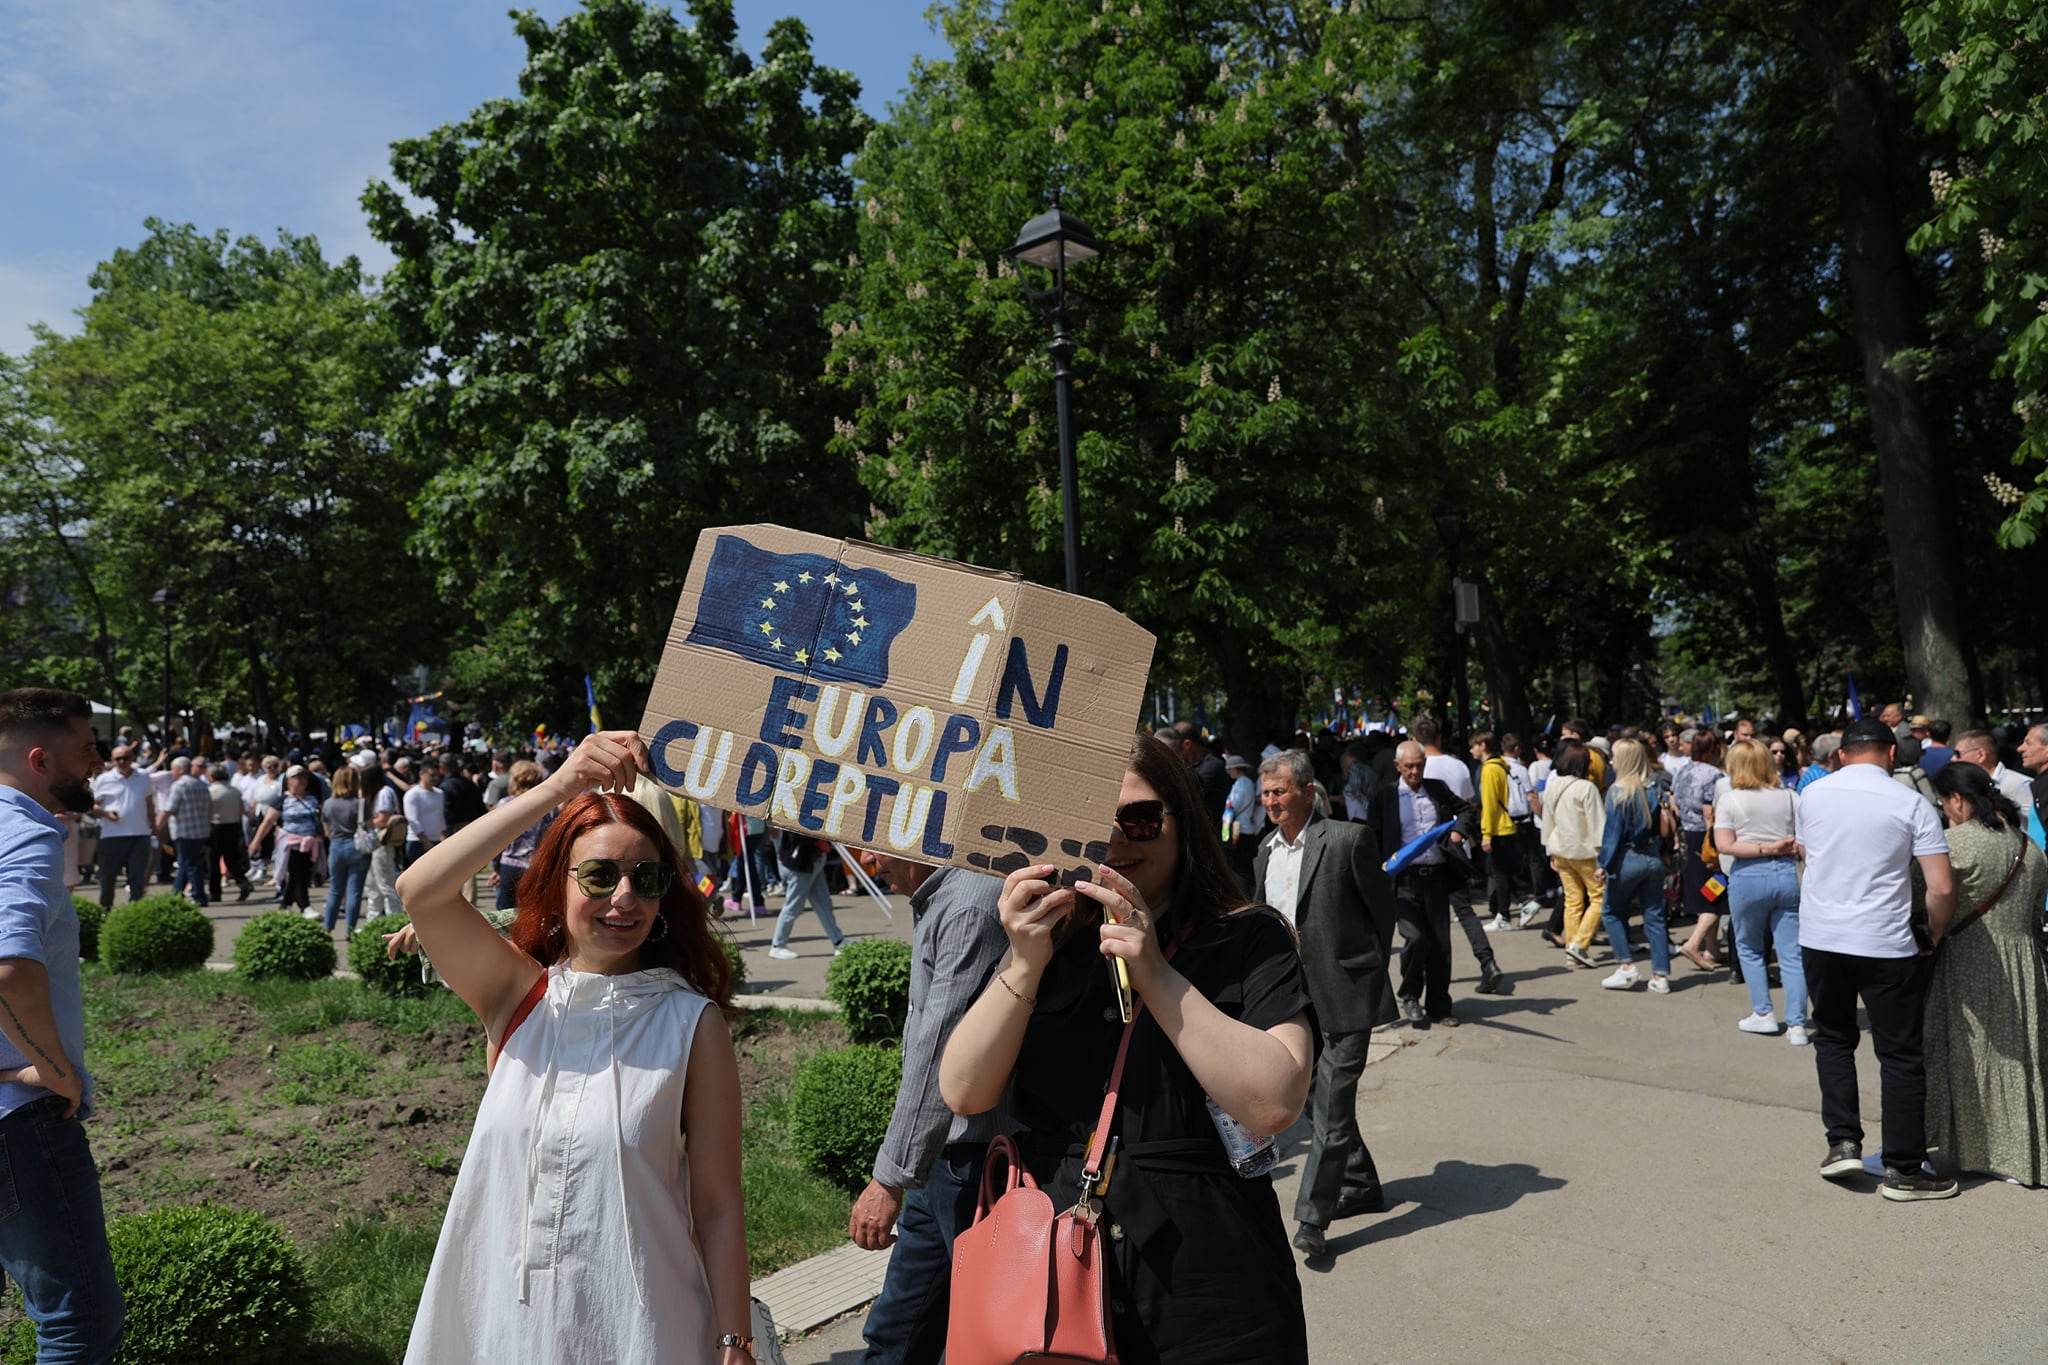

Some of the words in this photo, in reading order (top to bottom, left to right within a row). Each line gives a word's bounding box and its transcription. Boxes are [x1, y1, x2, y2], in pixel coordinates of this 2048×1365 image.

[950, 597, 1069, 728] ÎN
[649, 720, 733, 799] CU
[736, 743, 954, 858] DREPTUL
[759, 676, 1021, 803] EUROPA
